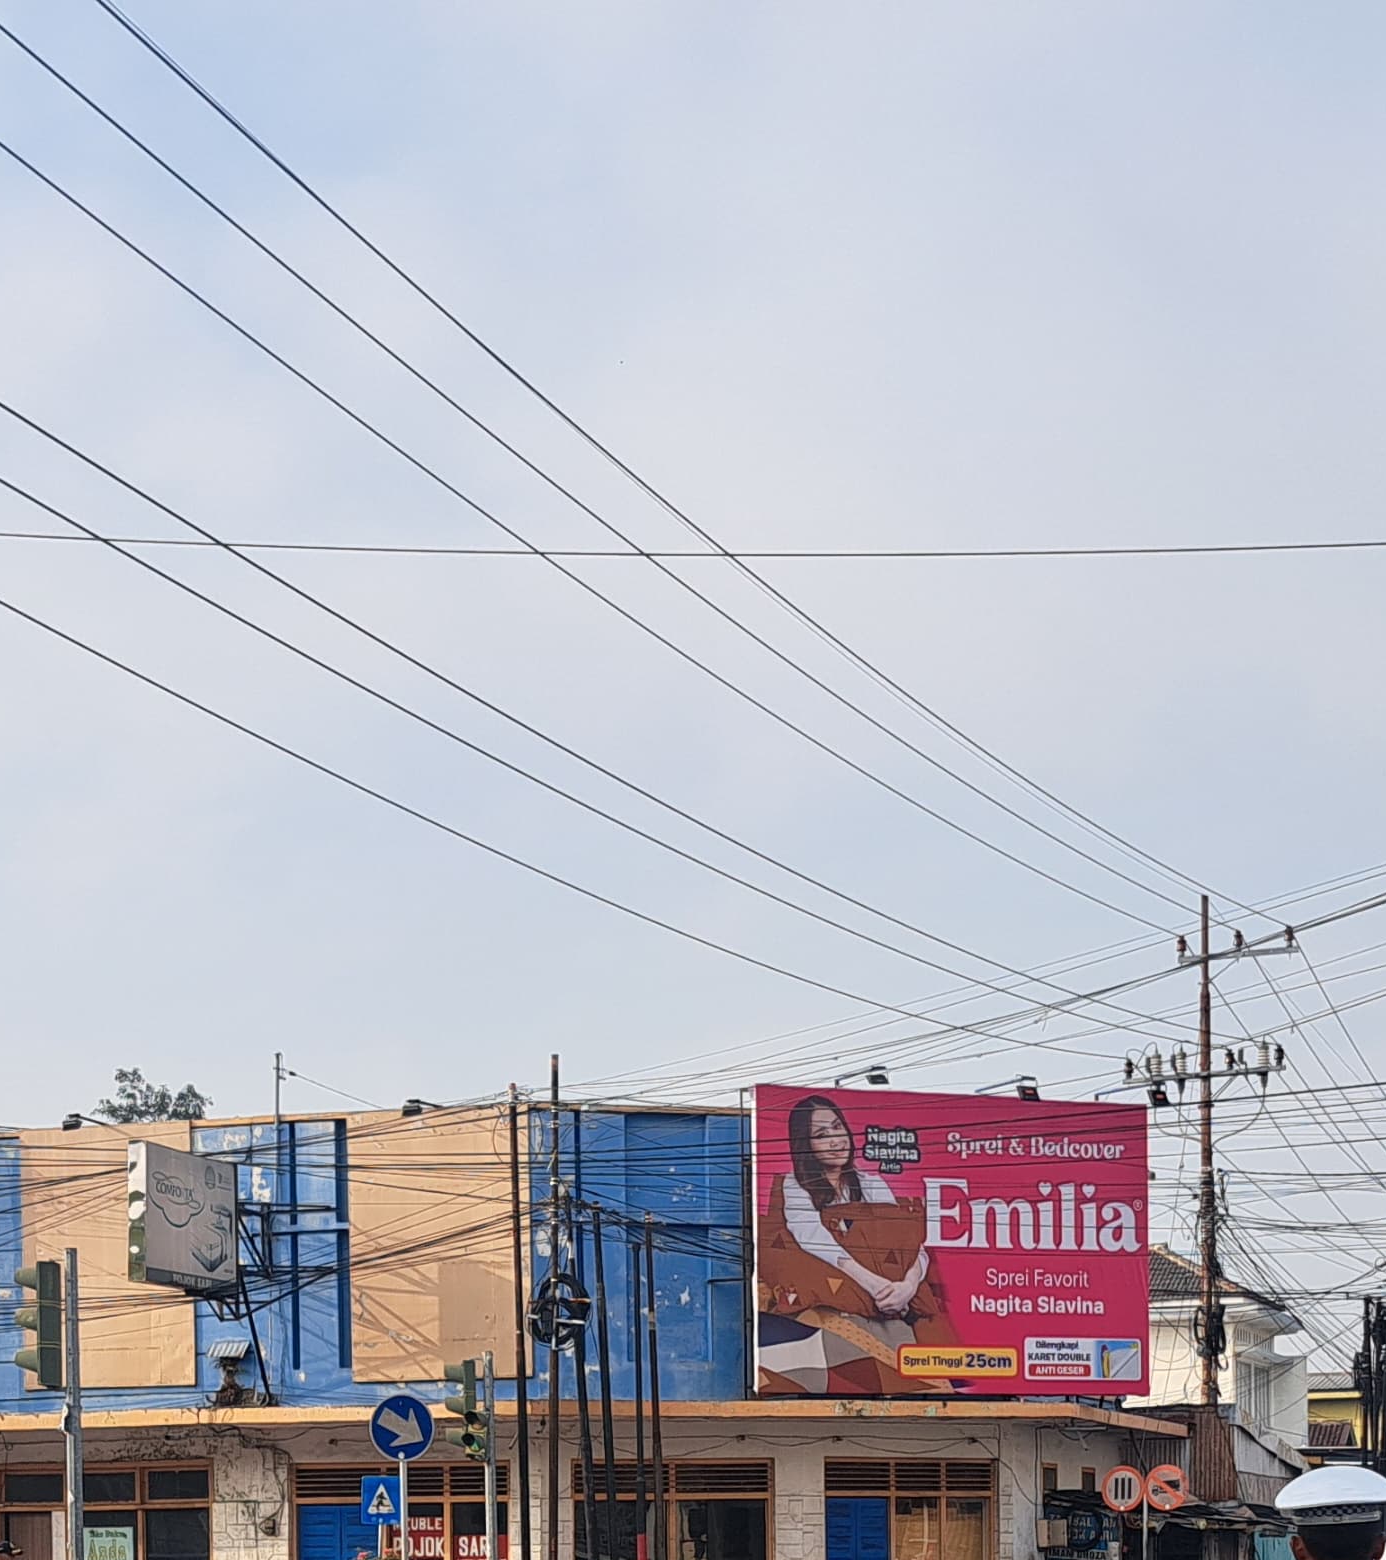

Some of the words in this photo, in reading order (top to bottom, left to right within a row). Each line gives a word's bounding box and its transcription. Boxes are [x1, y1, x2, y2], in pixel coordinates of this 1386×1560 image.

[867, 1128, 915, 1146] Nagita
[947, 1132, 1003, 1159] Sprei
[1008, 1137, 1024, 1157] &
[1031, 1136, 1124, 1159] Bedcover
[156, 1180, 194, 1200] COMFOTA
[922, 1177, 1142, 1253] Emilia
[986, 1268, 1029, 1289] Sprei
[1034, 1269, 1089, 1288] Favorit
[970, 1295, 1033, 1317] Nagita
[1037, 1295, 1105, 1315] Slavina
[903, 1356, 930, 1368] Sprei
[965, 1353, 1012, 1369] 25cm
[1028, 1352, 1056, 1361] KARET
[1057, 1352, 1091, 1361] DOUBLE
[1035, 1366, 1055, 1375] ANTI
[393, 1517, 443, 1531] MUBLE
[458, 1536, 489, 1557] SAR
